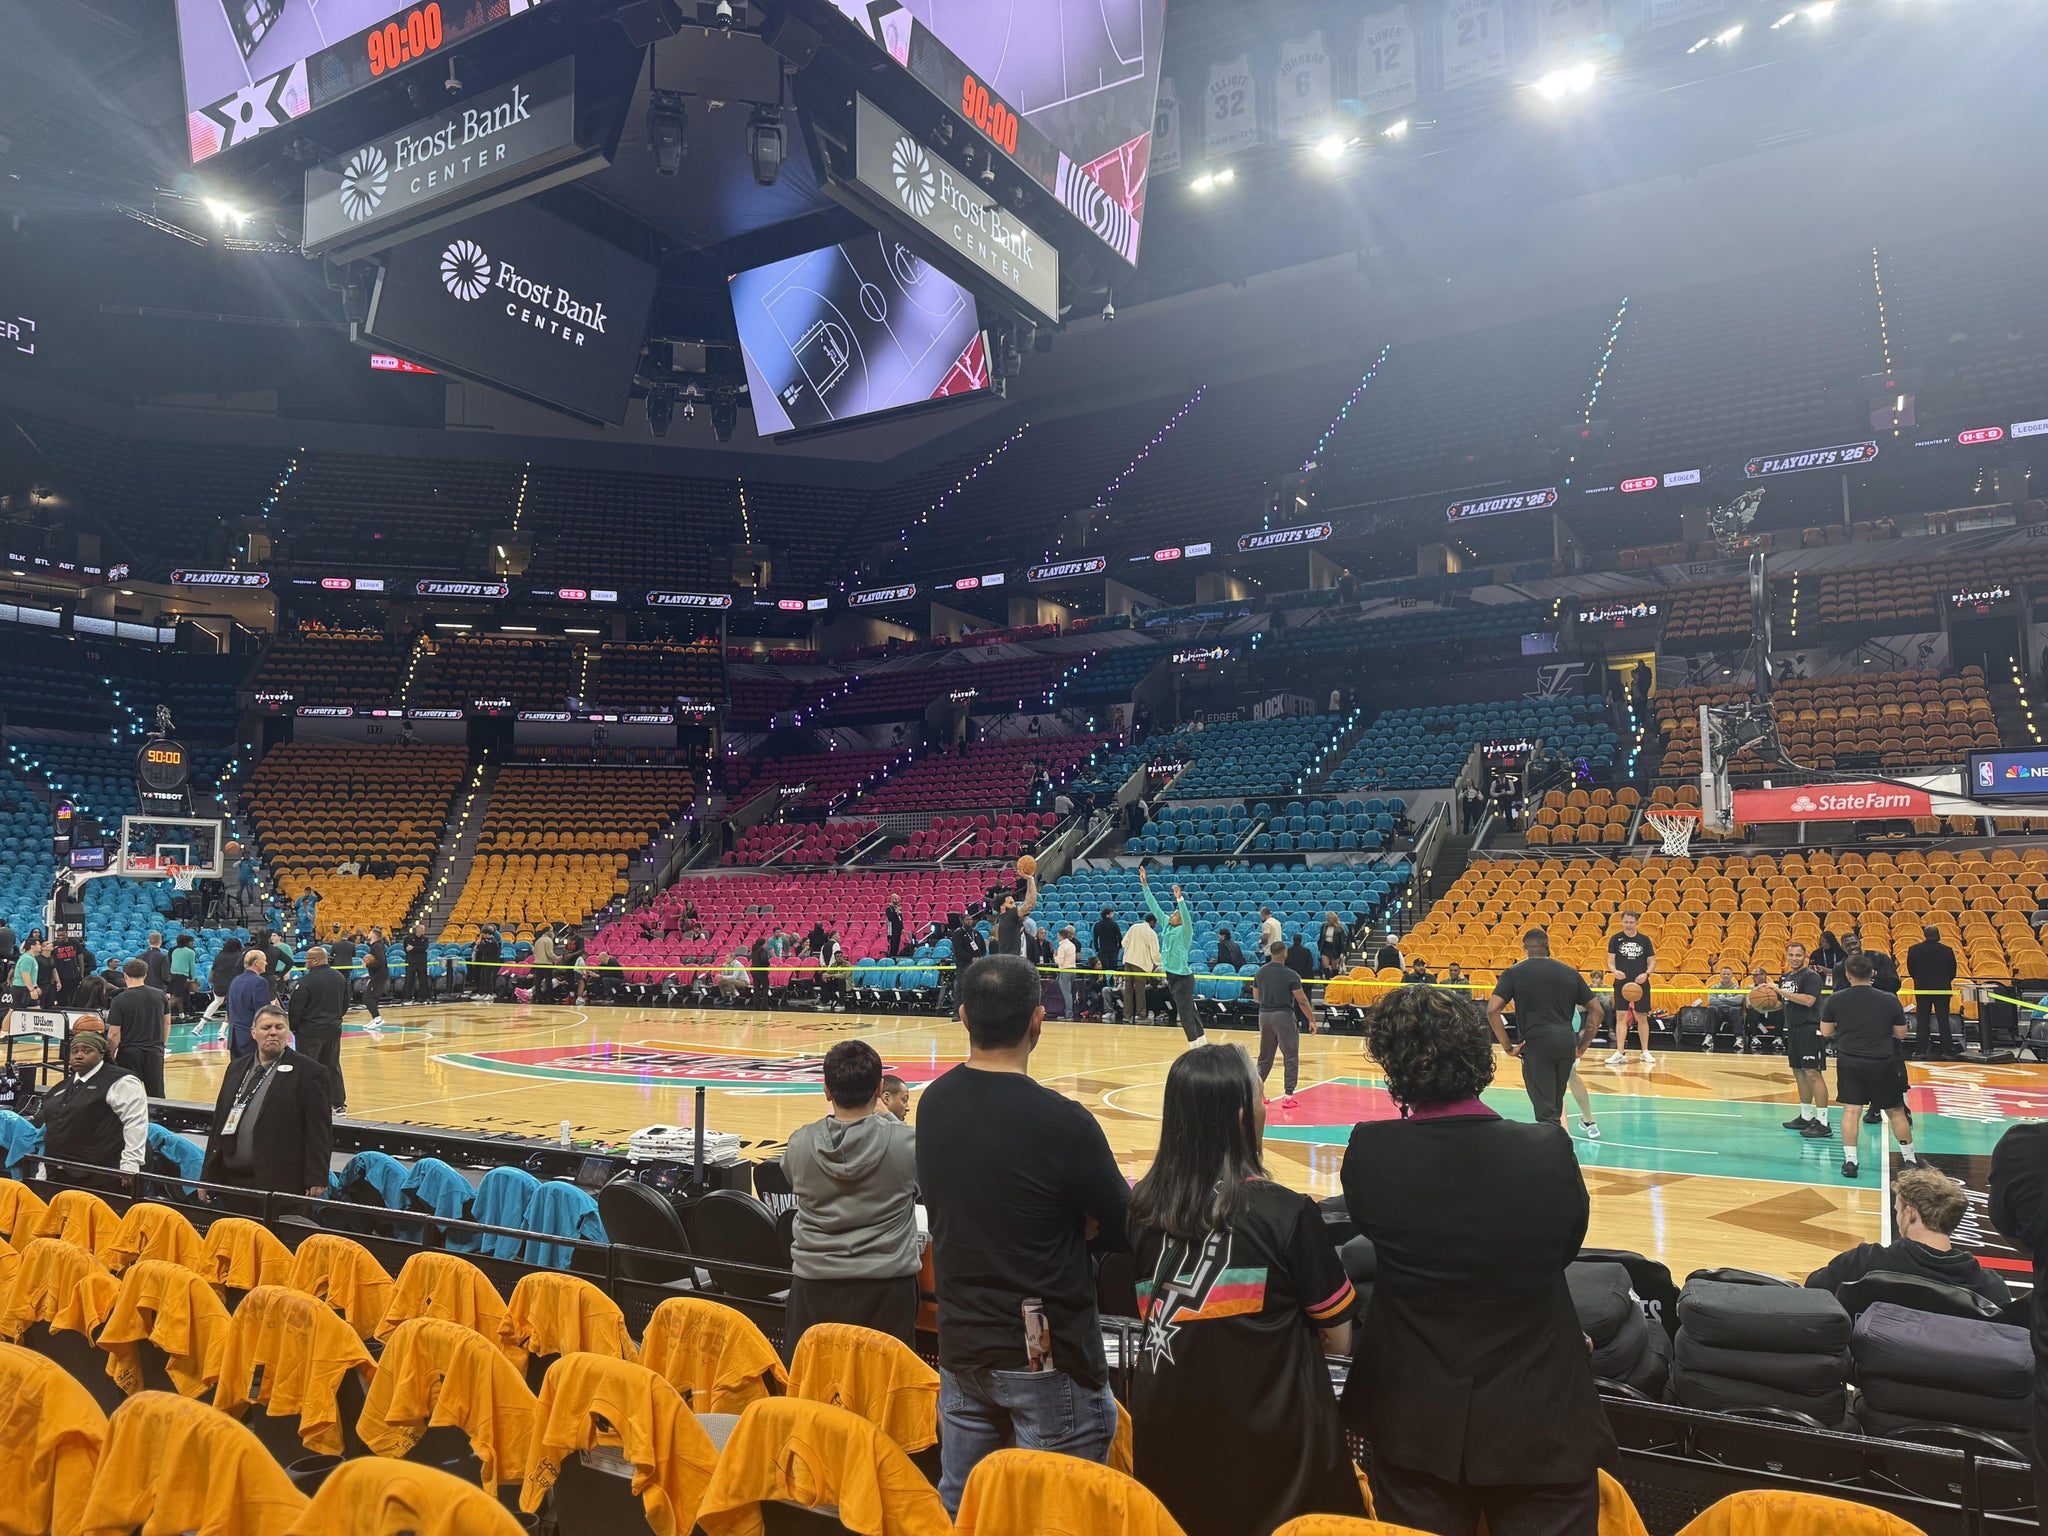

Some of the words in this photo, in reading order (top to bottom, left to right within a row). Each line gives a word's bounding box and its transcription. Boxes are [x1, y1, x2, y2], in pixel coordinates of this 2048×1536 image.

[368, 3, 443, 76] 90:00
[1457, 11, 1488, 46] 21
[1280, 52, 1326, 77] JOHNSON
[1372, 42, 1400, 74] 12
[1210, 74, 1249, 95] ELLIOTT
[1295, 70, 1312, 98] 6
[962, 75, 1018, 155] 90:00
[1214, 90, 1245, 120] 32
[394, 121, 457, 174] Frost
[461, 84, 532, 146] Bank
[409, 143, 507, 194] CENTER
[939, 168, 988, 235] Frost
[989, 211, 1034, 270] Bank
[953, 224, 1021, 285] CENTER
[495, 260, 552, 308] Frost
[556, 287, 607, 335] Bank
[505, 302, 585, 347] CENTER
[2017, 422, 2048, 433] LEDGER
[1761, 451, 1838, 473] PLAYOFFS
[1840, 446, 1865, 461] '26
[1669, 474, 1695, 483] LEDGER
[1460, 496, 1524, 516] PLAYOFFS
[1526, 492, 1547, 505] '26
[1250, 531, 1302, 548] PLAYOFFS
[1305, 526, 1322, 539] '26
[9, 553, 26, 561] BLK
[183, 573, 240, 584] PLAYOFFS
[242, 574, 260, 584] '26
[1036, 564, 1081, 578] PLAYOFFS
[1083, 560, 1098, 572] '26
[1690, 564, 1708, 574] 123
[428, 583, 481, 594] PLAYOFFS
[483, 586, 500, 595] '26
[657, 594, 706, 605] PLAYOFFS
[708, 597, 724, 606] '26
[856, 590, 895, 603] PLAYOFFS
[896, 587, 909, 598] '26
[148, 750, 181, 765] 90:00
[154, 792, 183, 801] TISSOT
[1818, 794, 1865, 811] State
[1866, 792, 1911, 809] Farm
[33, 1015, 53, 1028] Wilson
